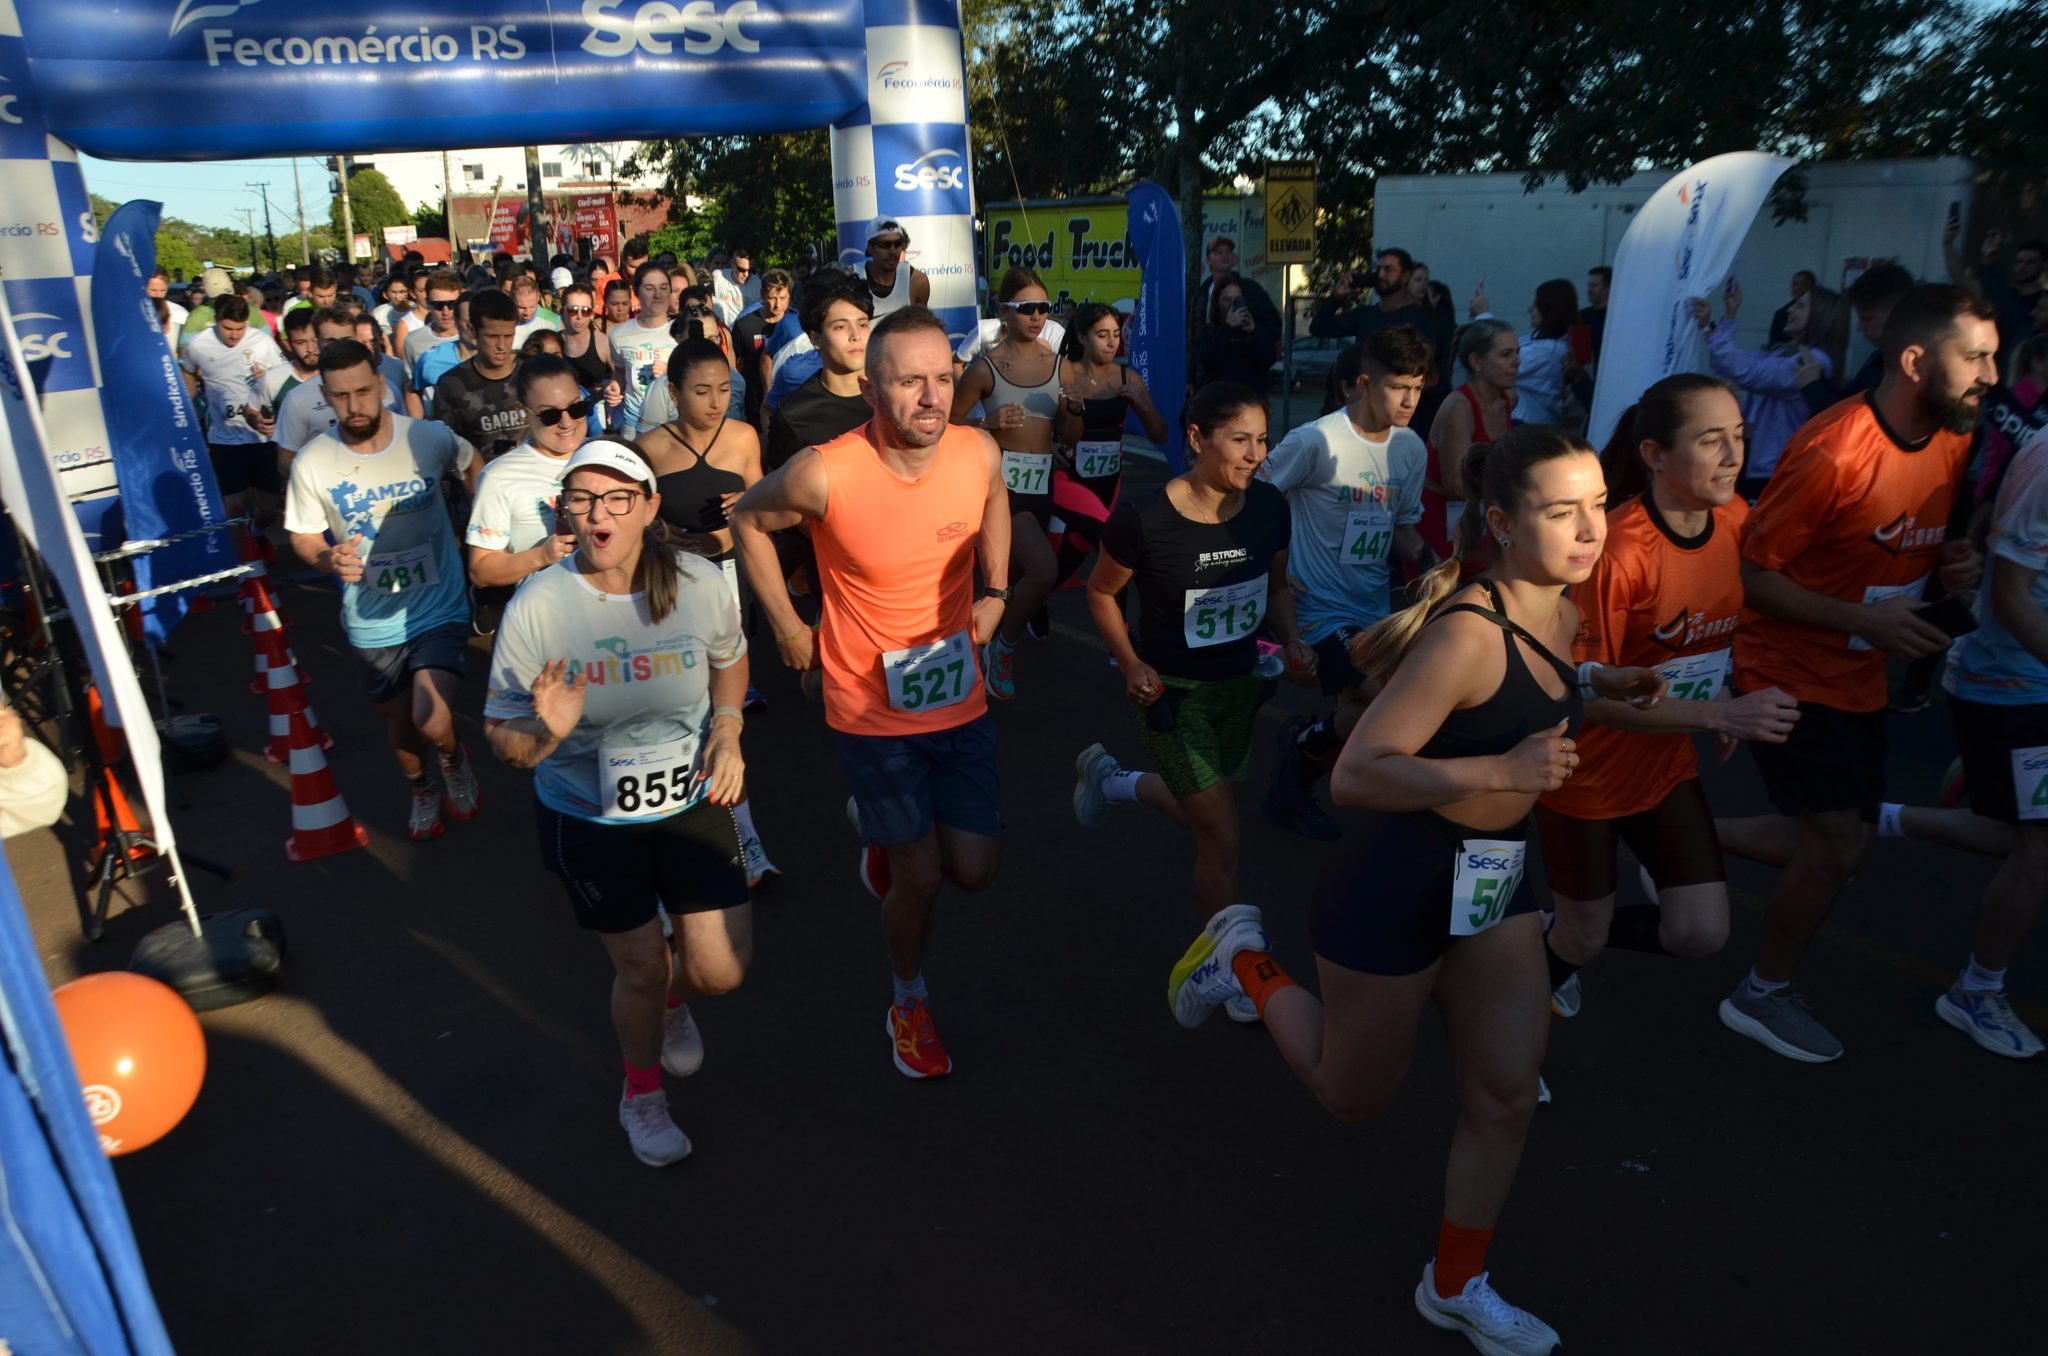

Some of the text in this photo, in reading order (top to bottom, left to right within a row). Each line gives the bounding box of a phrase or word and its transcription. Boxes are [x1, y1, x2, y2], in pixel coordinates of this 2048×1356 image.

[580, 0, 761, 57] Sesc
[203, 24, 526, 66] Fecomércio RS
[894, 163, 963, 191] Sesc
[1269, 166, 1313, 178] DEVAGAR
[37, 222, 60, 236] RS
[993, 217, 1139, 271] Food Truck
[1271, 238, 1311, 252] ELEVADA
[913, 263, 963, 277] omércio
[1083, 454, 1119, 475] 475
[1007, 467, 1045, 490] 317
[1199, 547, 1247, 562] BE STRONG
[1350, 531, 1391, 560] 447
[377, 561, 428, 591] 481
[1195, 599, 1258, 640] 513
[902, 658, 964, 710] 527
[1660, 669, 1680, 680] esc
[1672, 678, 1713, 700] 76
[617, 764, 691, 813] 855
[2031, 773, 2048, 806] 4
[1468, 854, 1510, 871] Sesc
[1191, 958, 1220, 985] FILA
